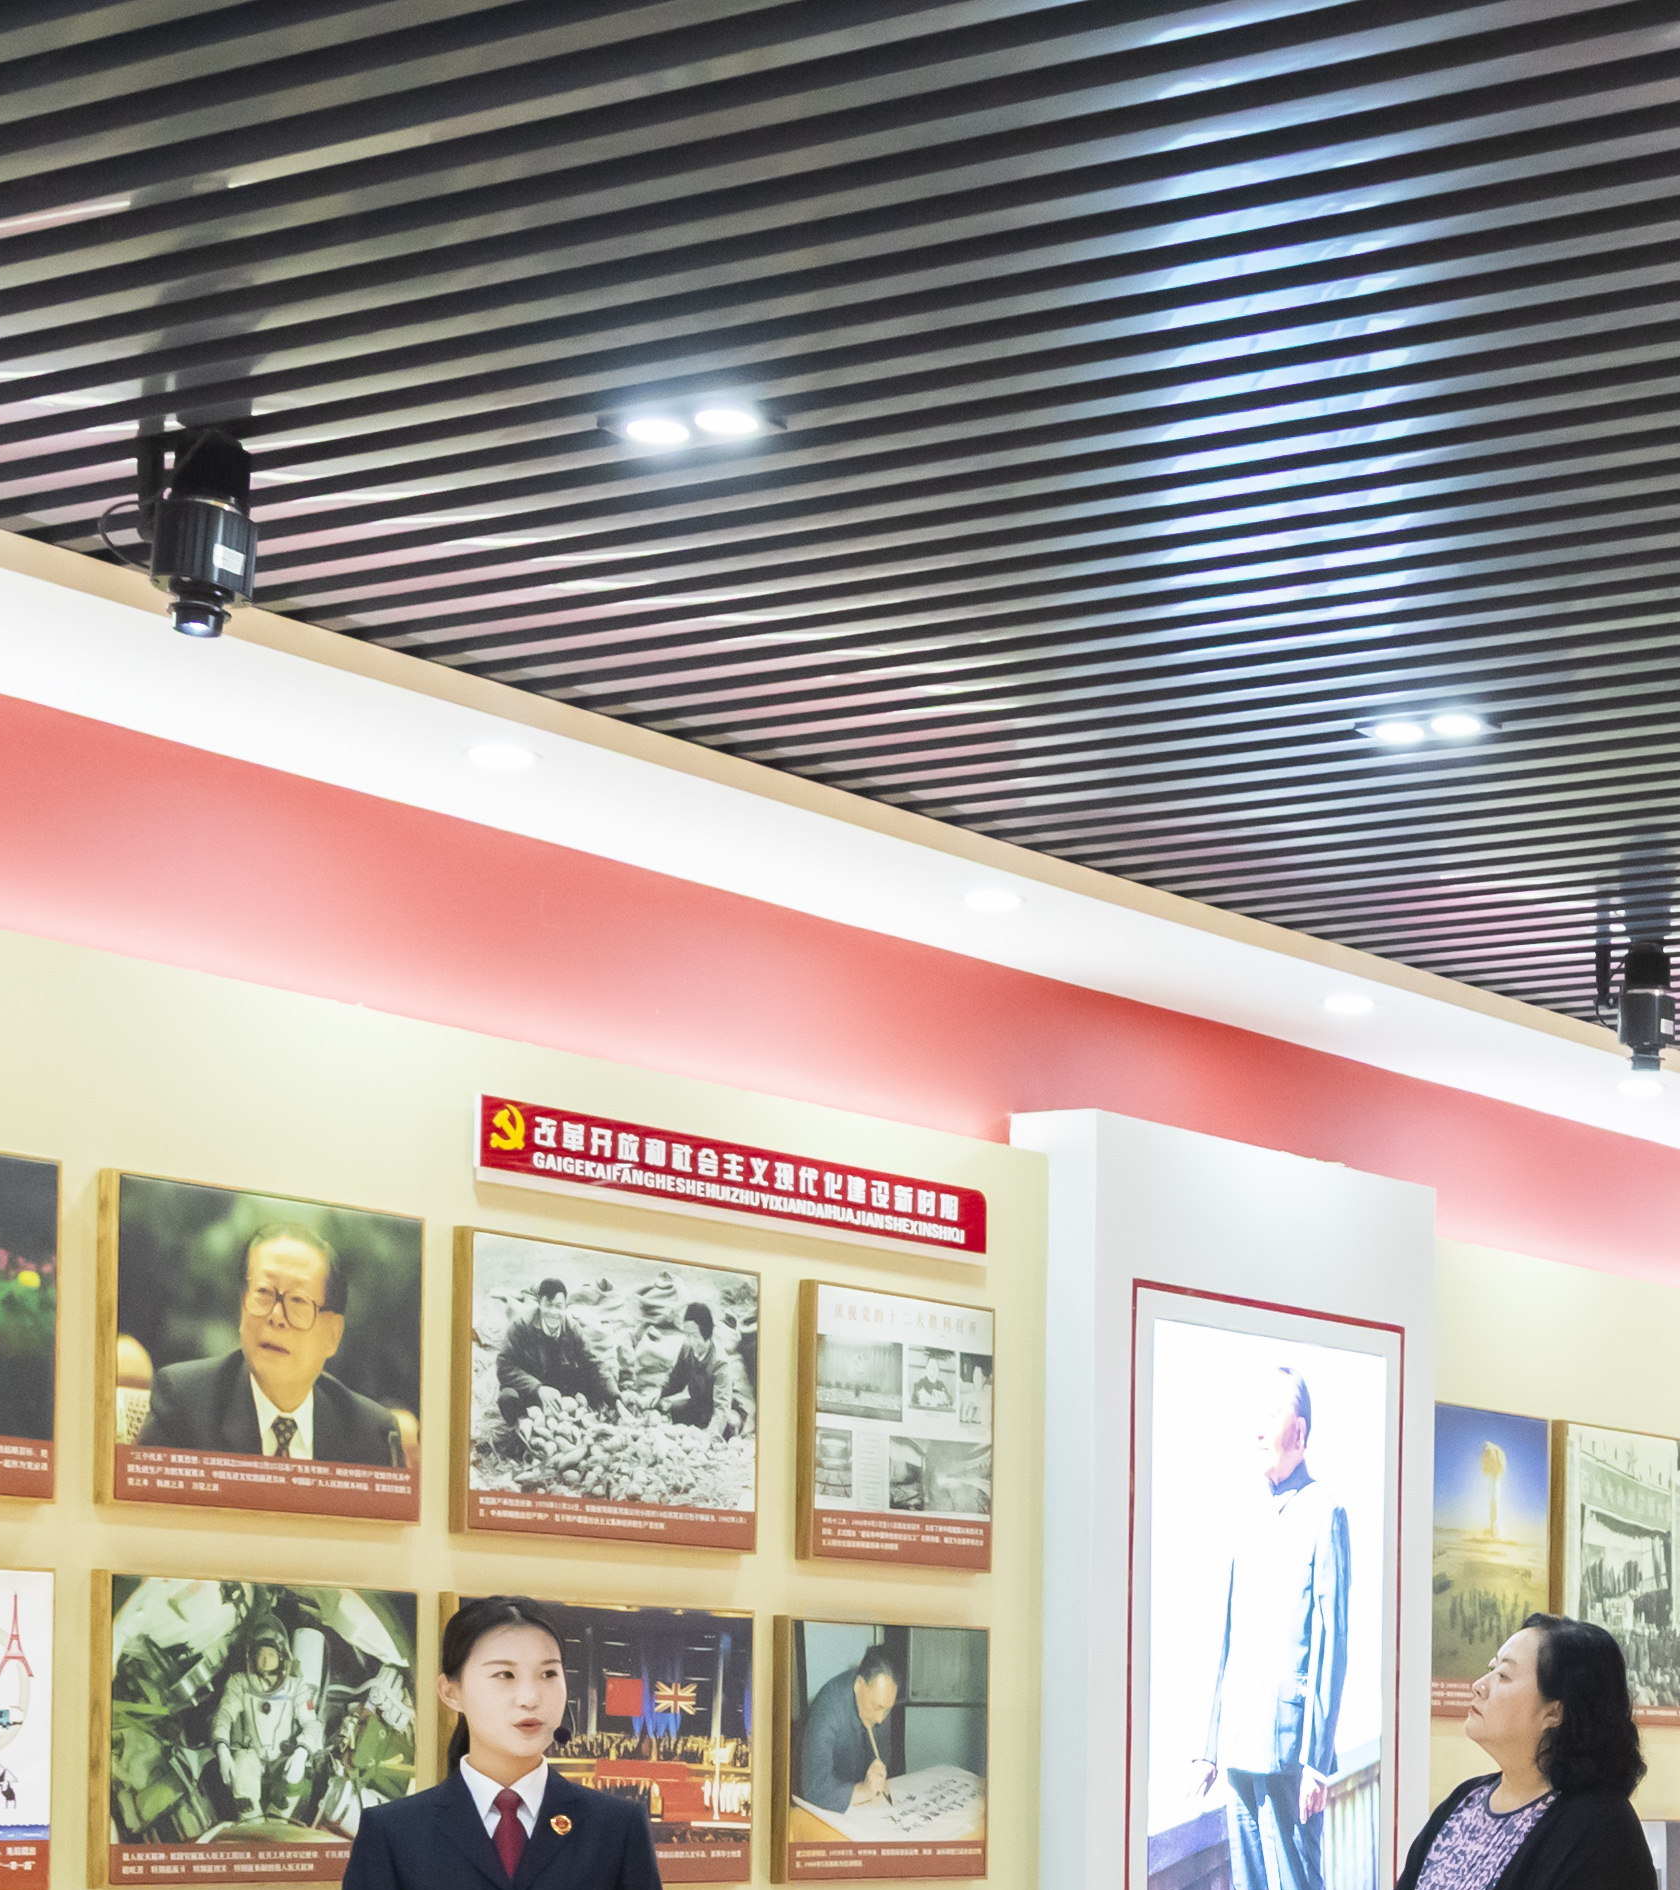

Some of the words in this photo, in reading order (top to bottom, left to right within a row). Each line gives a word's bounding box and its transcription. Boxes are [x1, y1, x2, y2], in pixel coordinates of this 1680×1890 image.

[534, 1116, 959, 1221] 改革开放和社会主义现代化建设新时期
